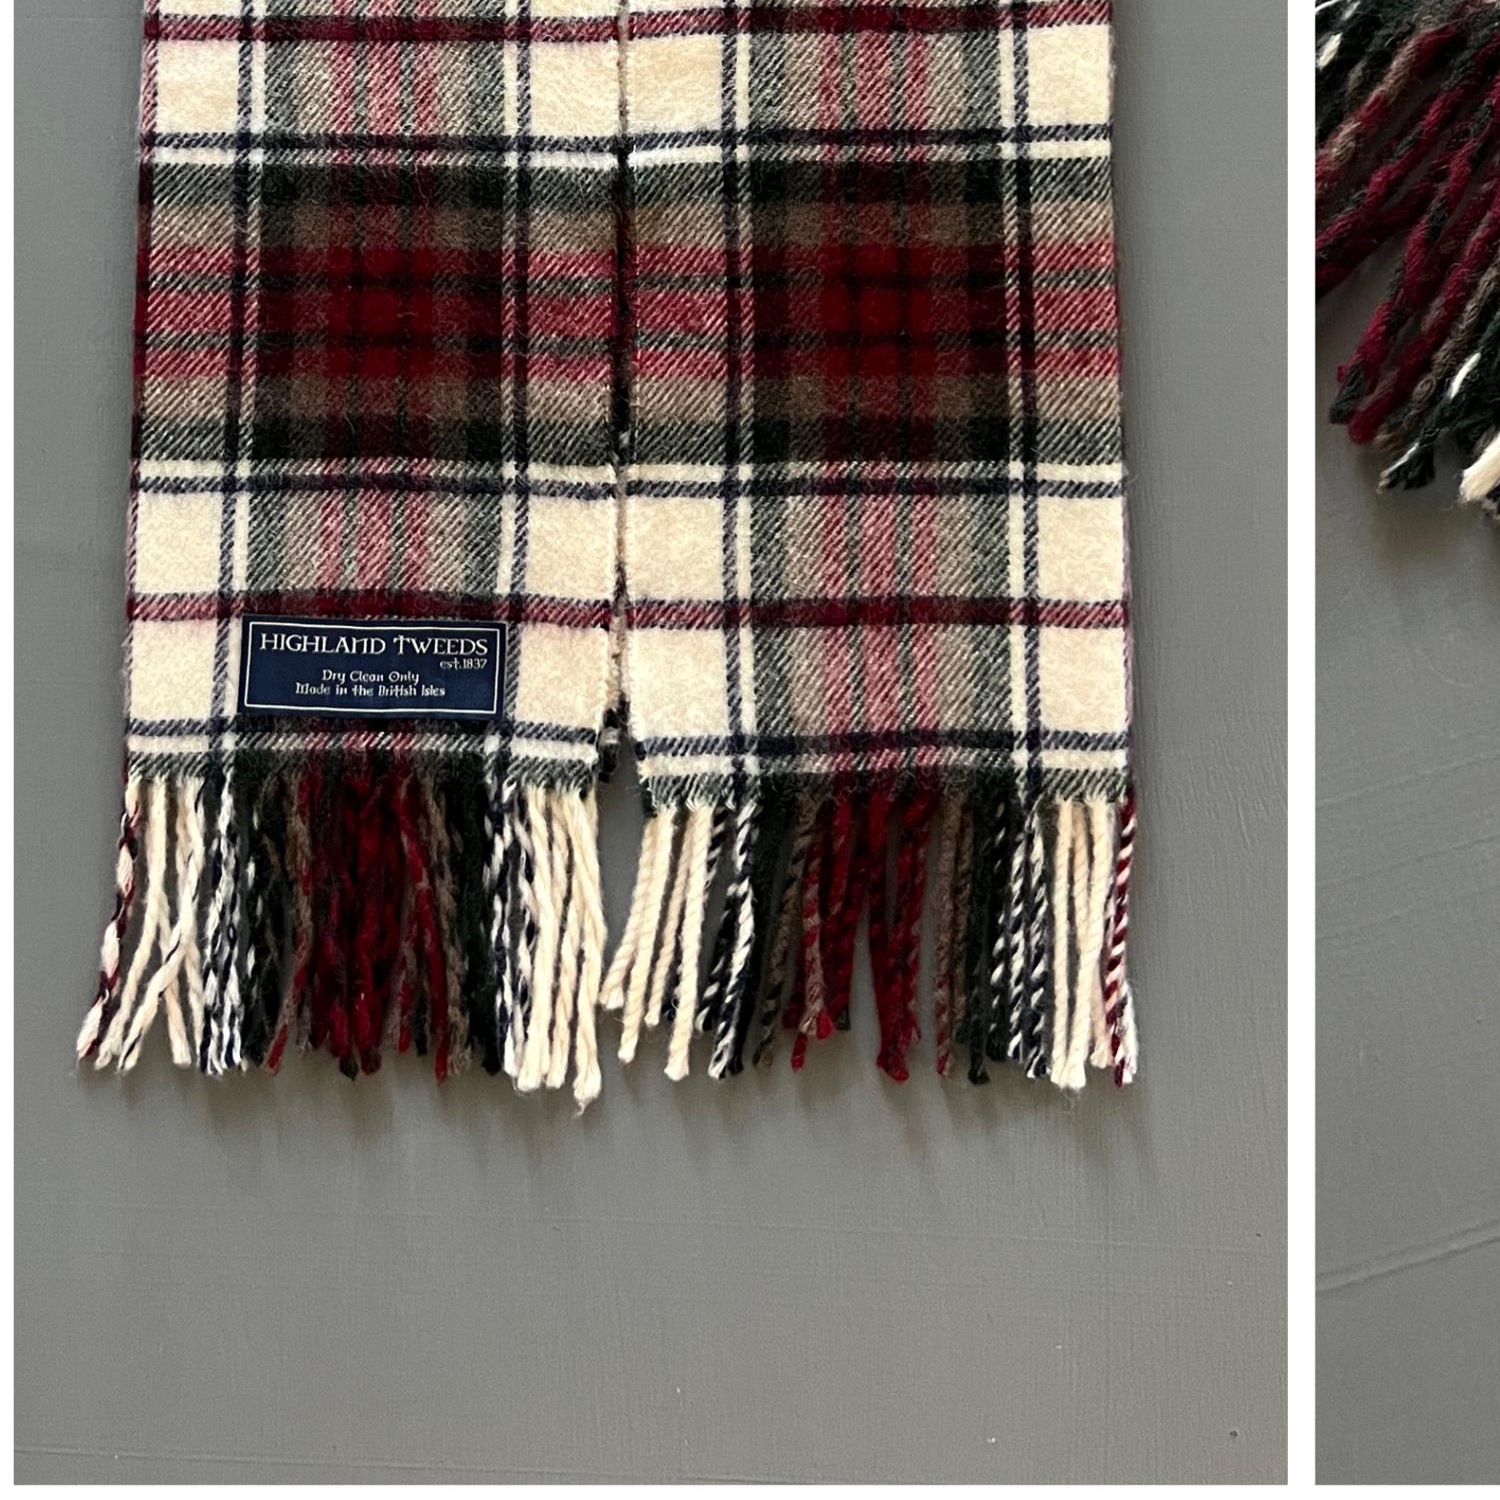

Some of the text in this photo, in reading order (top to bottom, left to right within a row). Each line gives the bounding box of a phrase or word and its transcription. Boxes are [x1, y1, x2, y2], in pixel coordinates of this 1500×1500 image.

[260, 632, 488, 655] HIGHLAND TWEEDS
[322, 669, 419, 686] Dry Clean Only
[295, 682, 446, 698] Made in the British Isles
